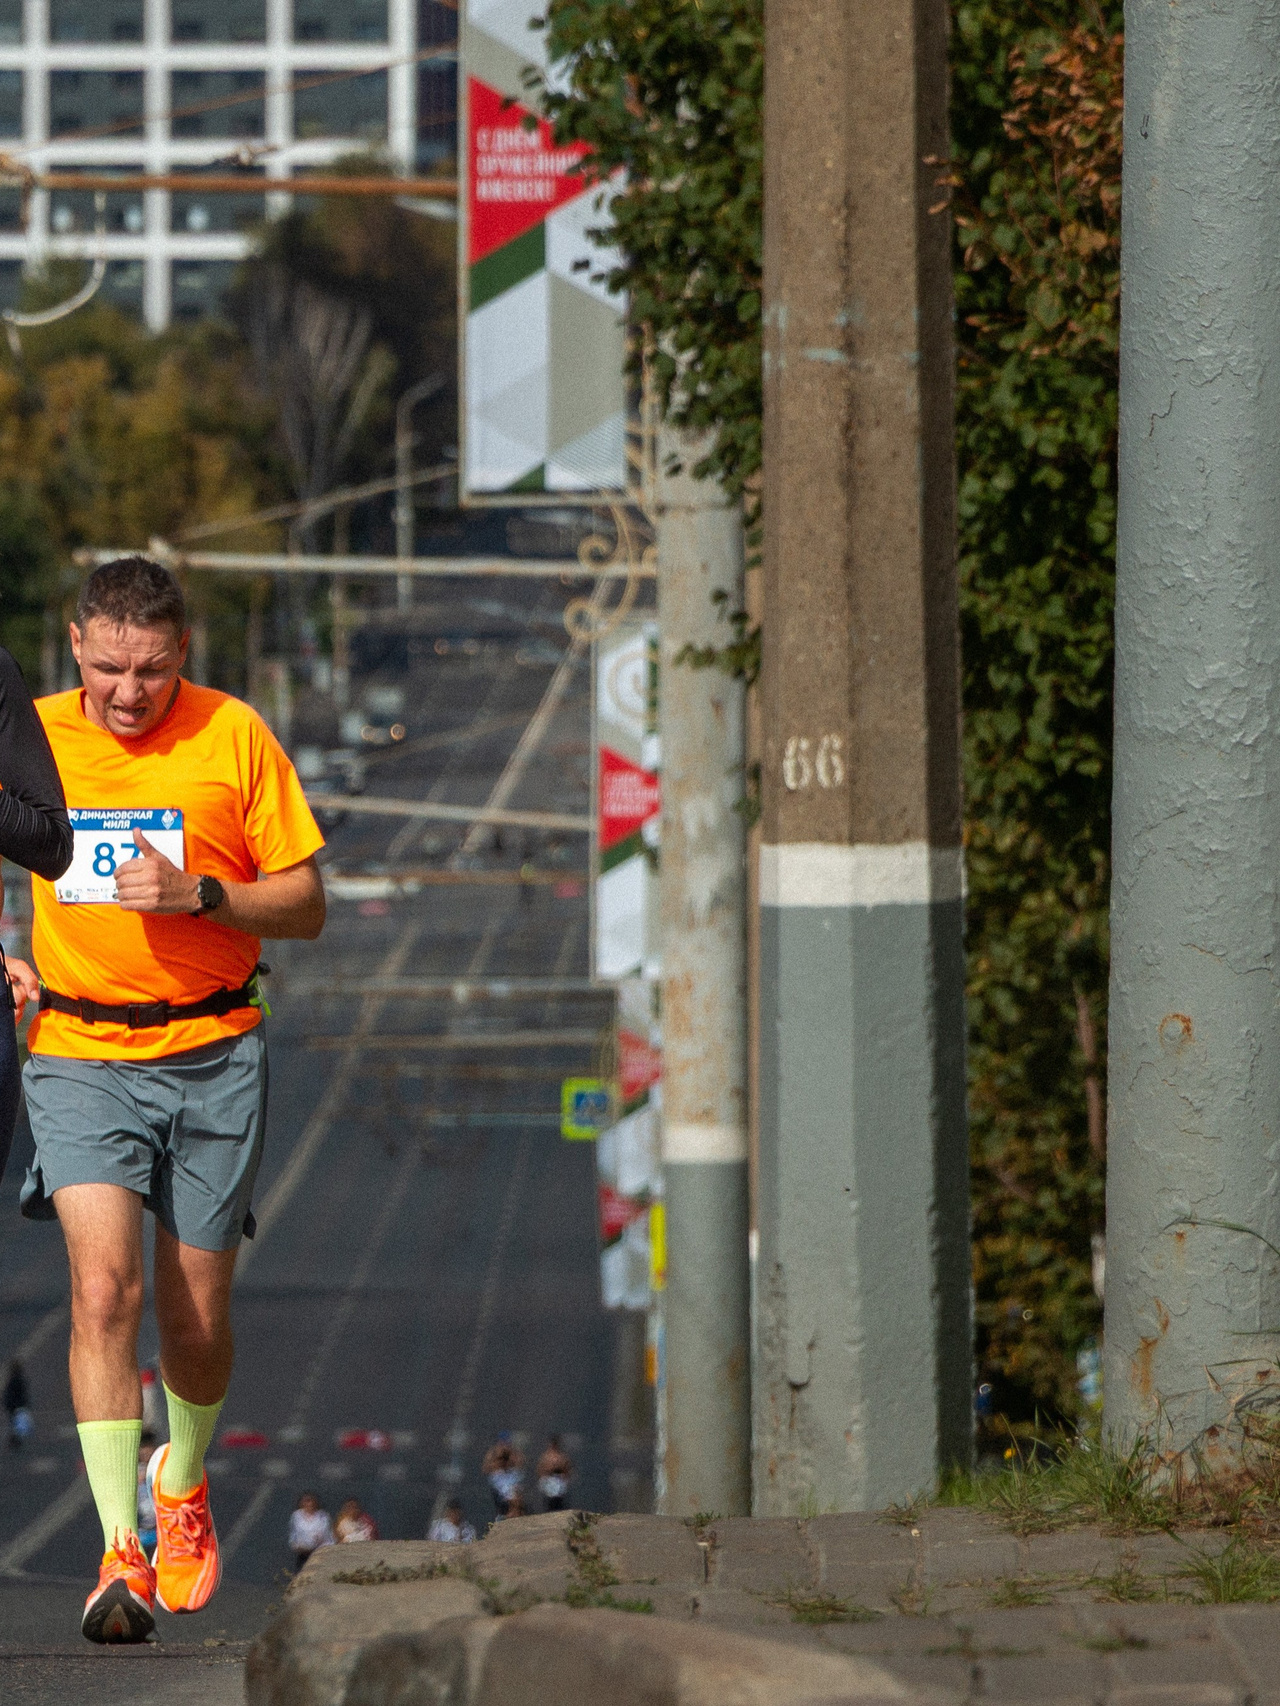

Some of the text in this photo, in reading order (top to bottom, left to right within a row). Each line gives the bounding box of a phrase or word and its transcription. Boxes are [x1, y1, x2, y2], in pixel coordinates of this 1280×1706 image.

[782, 734, 845, 790] 66
[79, 810, 154, 820] ДИНАМОВСКАЯ
[102, 820, 130, 829] МИЛЯ
